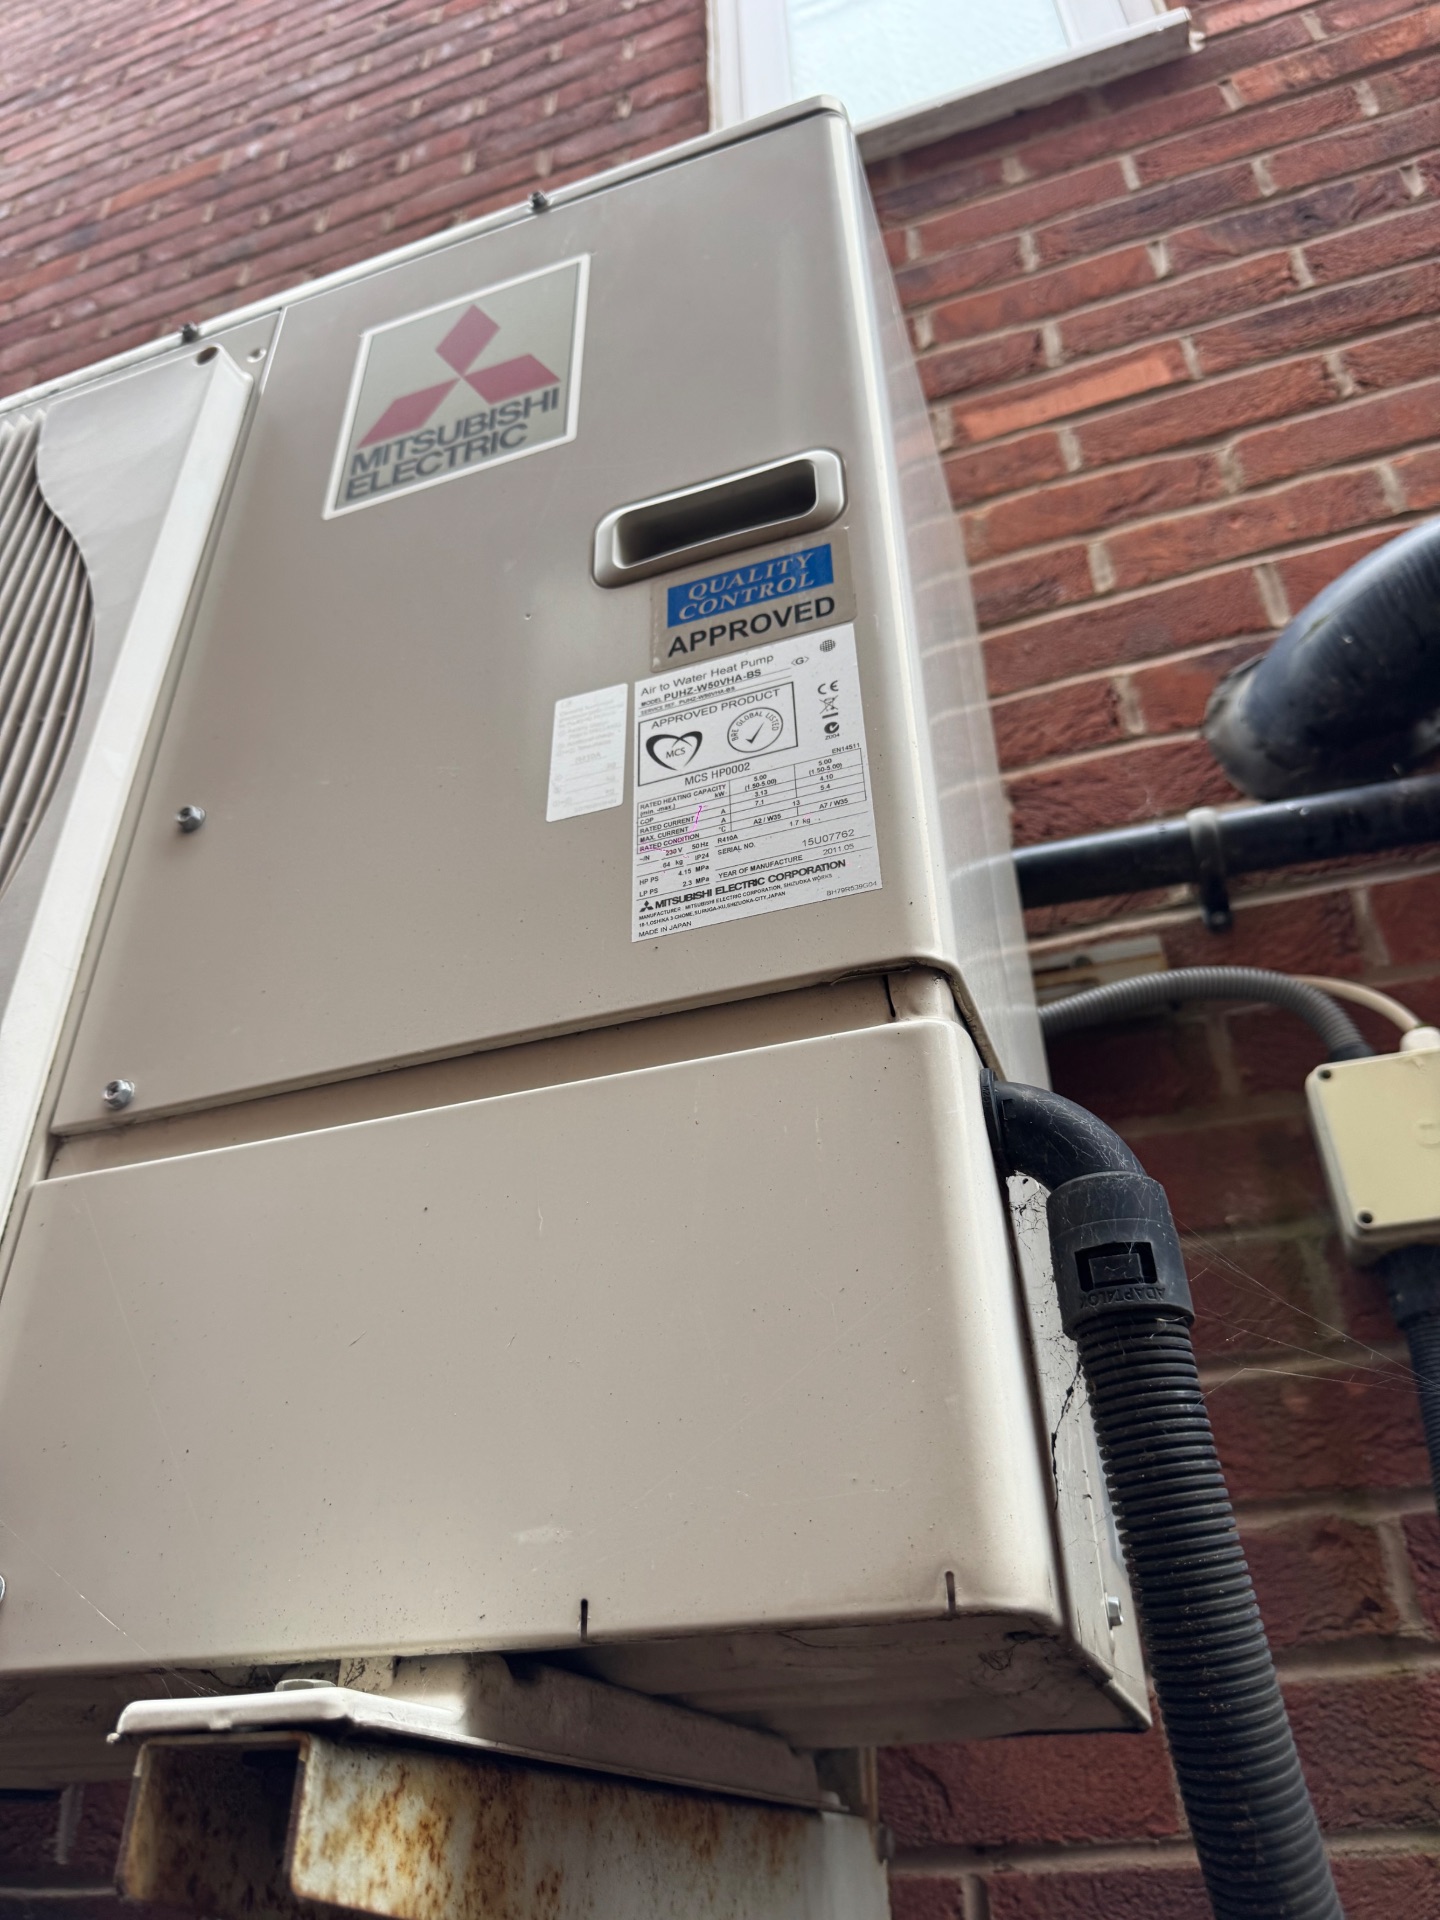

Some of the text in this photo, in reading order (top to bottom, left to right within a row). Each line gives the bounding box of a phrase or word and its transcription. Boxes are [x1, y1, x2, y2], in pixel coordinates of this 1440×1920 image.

[351, 387, 560, 476] MITSUBISHI
[345, 423, 528, 501] ELECTRIC
[688, 552, 814, 600] QUALITY
[679, 573, 814, 620] CONTROL
[668, 596, 835, 658] APPROVED
[641, 686, 657, 697] Air
[660, 682, 670, 692] to
[673, 672, 707, 688] Water
[710, 664, 737, 678] Heat
[740, 654, 774, 670] Pump
[641, 668, 761, 707] MODEL PUHZ-W50VHA-BS
[651, 705, 718, 730] APPROVED
[721, 688, 780, 711] PRODUCT
[730, 711, 779, 742] BRE GLOBAL LISTED
[665, 747, 686, 759] MCS
[831, 742, 860, 754] EN14511
[818, 758, 832, 766] 5.00
[684, 762, 750, 786] MCS HP0002
[753, 774, 767, 782] 5.00
[819, 774, 833, 782] 4.10
[754, 789, 768, 798] 3.13
[820, 783, 830, 791] 5.4
[640, 784, 726, 810] RATED HEATING CAPACITY
[640, 817, 654, 825] COP
[640, 816, 695, 834] RATED CURRENT
[657, 826, 689, 839] CURRENT
[717, 834, 738, 844] R410A
[801, 828, 855, 847] 15U07762
[639, 833, 700, 852] RATED CONDITION
[717, 845, 741, 856] SERIAL
[822, 843, 855, 856] 2011.05
[665, 848, 677, 856] 230
[694, 852, 709, 861] IP24
[678, 867, 692, 876] 4.15
[718, 854, 803, 879] YEAR OF MANUFACTURE
[655, 859, 846, 909] MITSUBISHI ELECTRIC CORPORATION
[685, 900, 715, 910] MITSUBISHI
[715, 893, 742, 903] ELECTRIC
[783, 877, 812, 888] SHIZUOKA
[812, 873, 833, 883] WORKS
[638, 928, 659, 938] MADE
[669, 920, 692, 931] JAPAN
